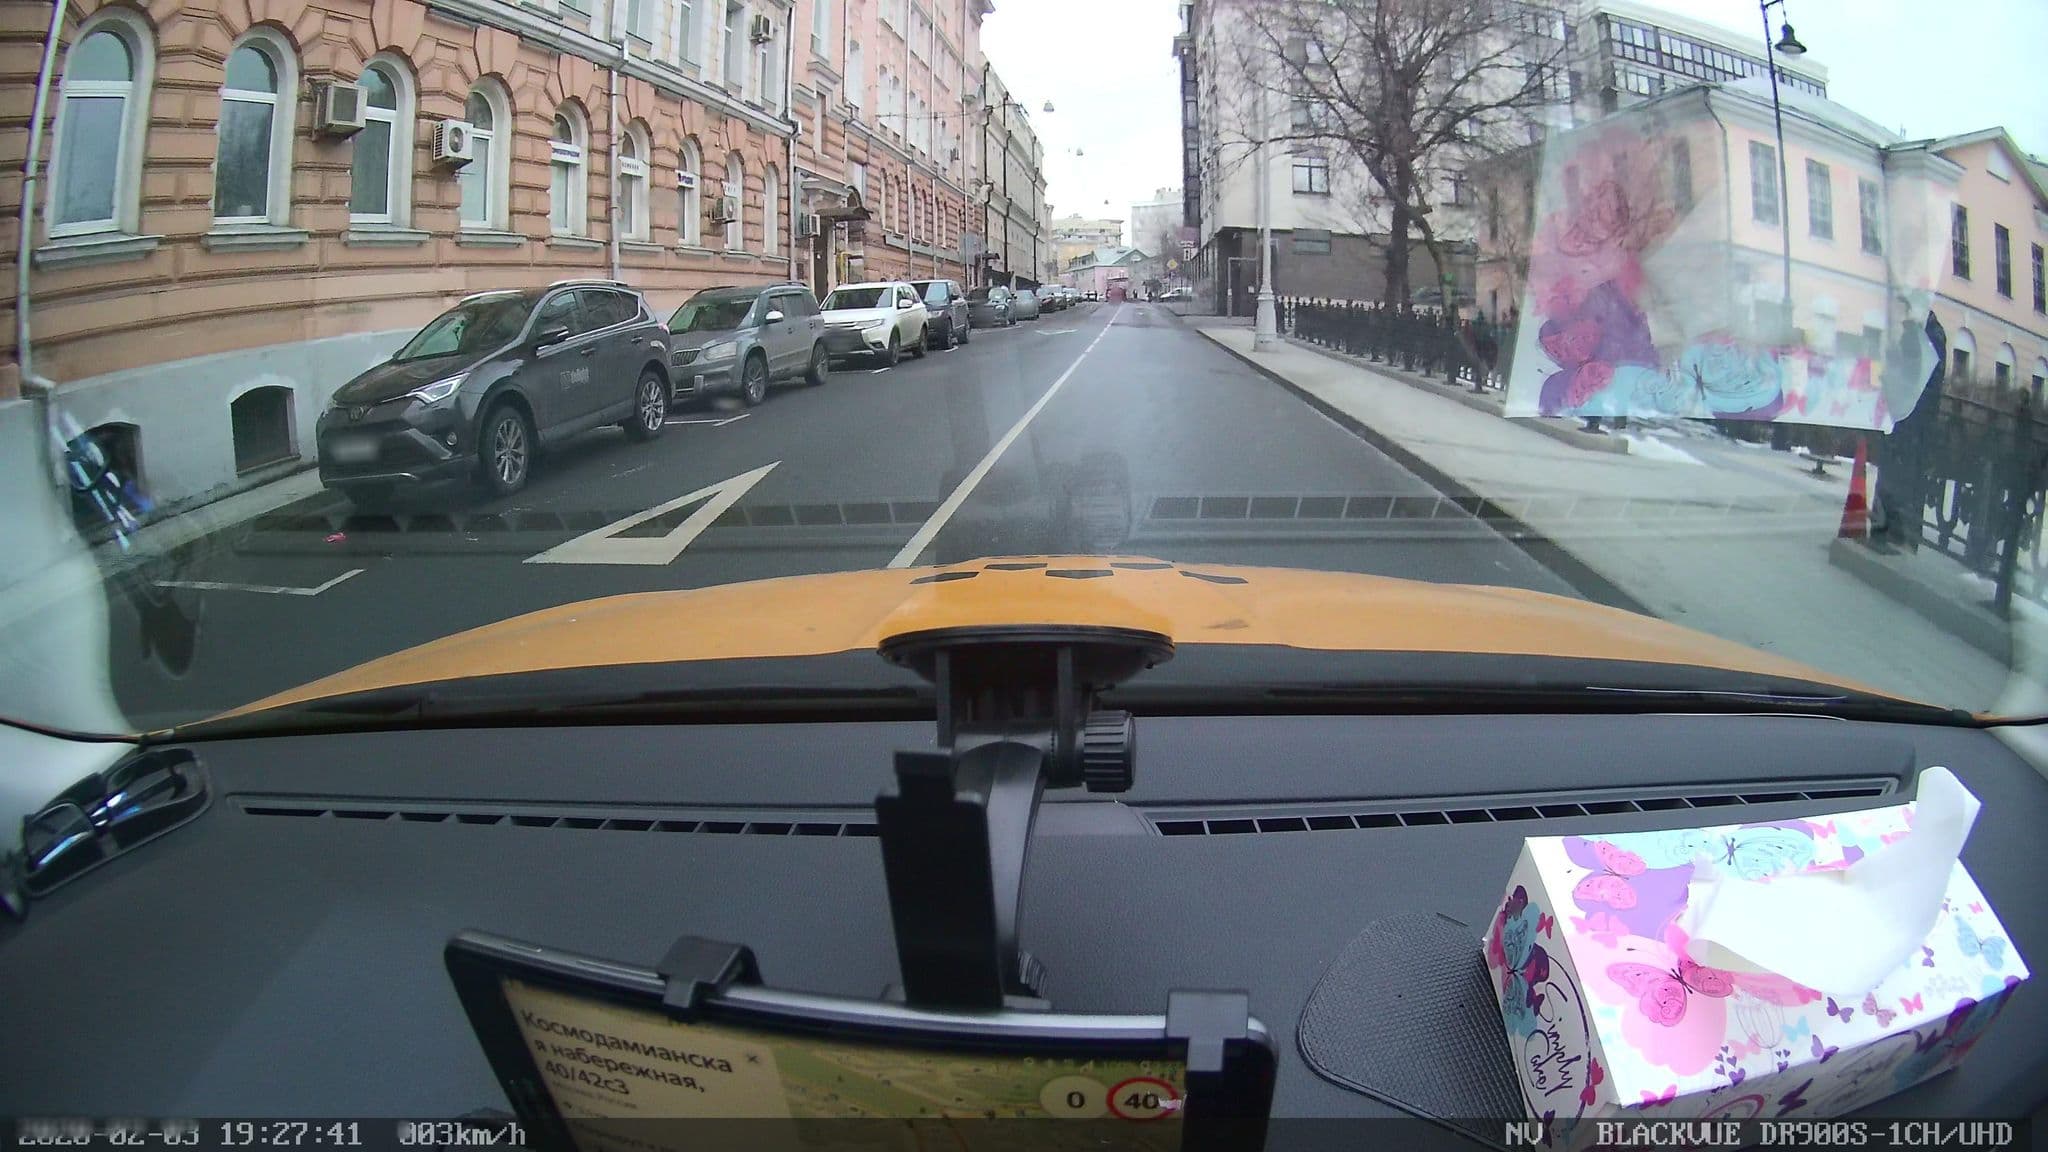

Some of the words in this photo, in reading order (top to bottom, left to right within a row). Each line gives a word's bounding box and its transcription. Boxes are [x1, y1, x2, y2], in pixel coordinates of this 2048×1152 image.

[521, 1009, 733, 1073] Космодамианска
[534, 1039, 546, 1051] я
[549, 1047, 705, 1093] набережная,
[1524, 1029, 1551, 1090] Care
[1537, 981, 1580, 1097] Simply
[1066, 1091, 1085, 1109] 0
[1124, 1093, 1160, 1109] 40
